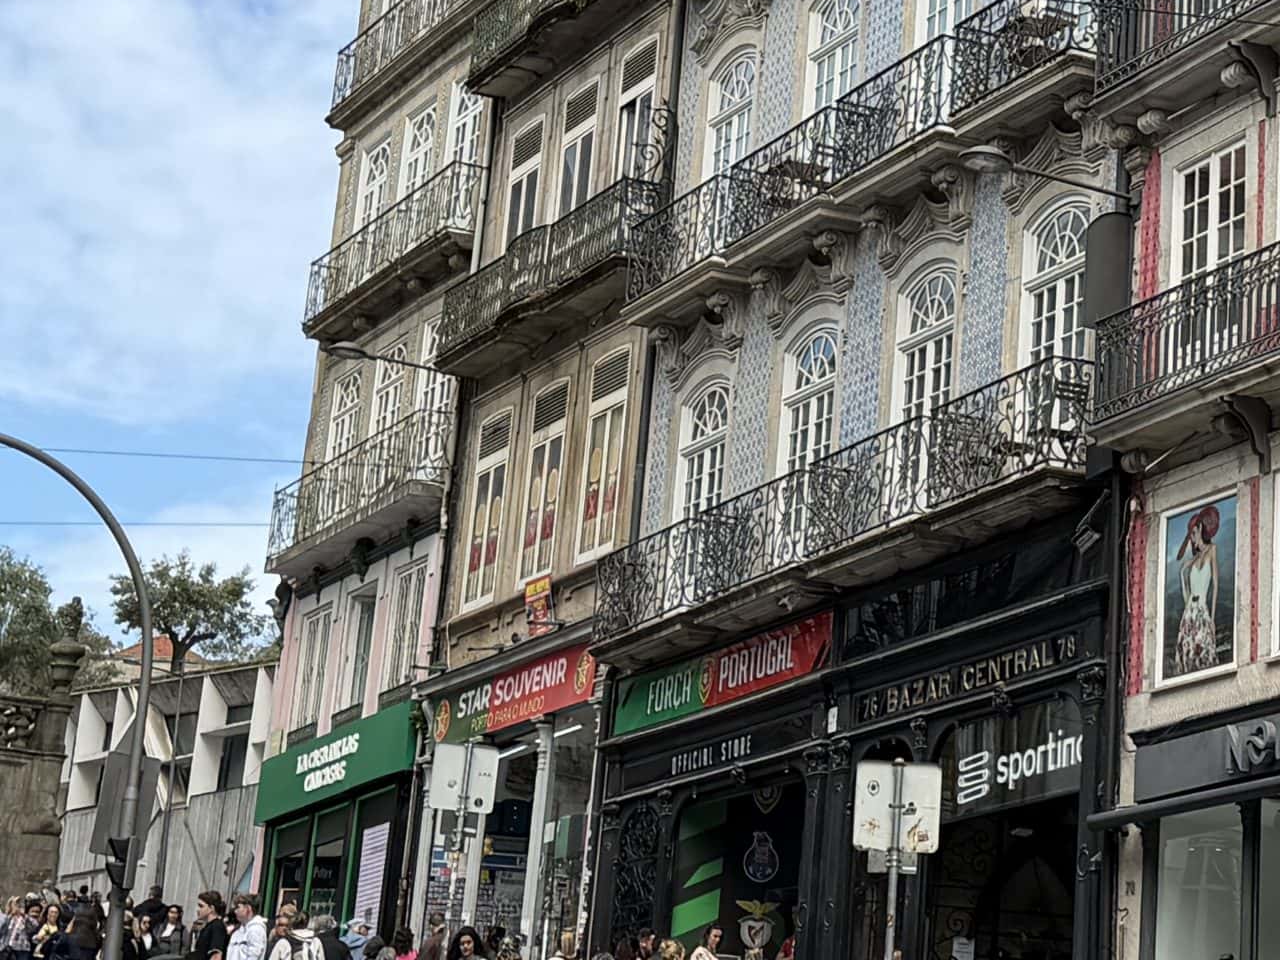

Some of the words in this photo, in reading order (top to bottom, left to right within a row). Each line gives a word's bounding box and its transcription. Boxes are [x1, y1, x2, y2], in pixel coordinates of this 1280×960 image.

[456, 683, 492, 719] STAR
[493, 657, 568, 706] SOUVENIR
[647, 671, 692, 715] FORÇA
[718, 634, 795, 692] PORTUGAL
[885, 671, 951, 714] BAZAR
[960, 641, 1054, 690] CENTRAL
[1057, 635, 1077, 661] 78
[671, 747, 713, 776] OFFICIAL
[720, 734, 752, 761] STORE
